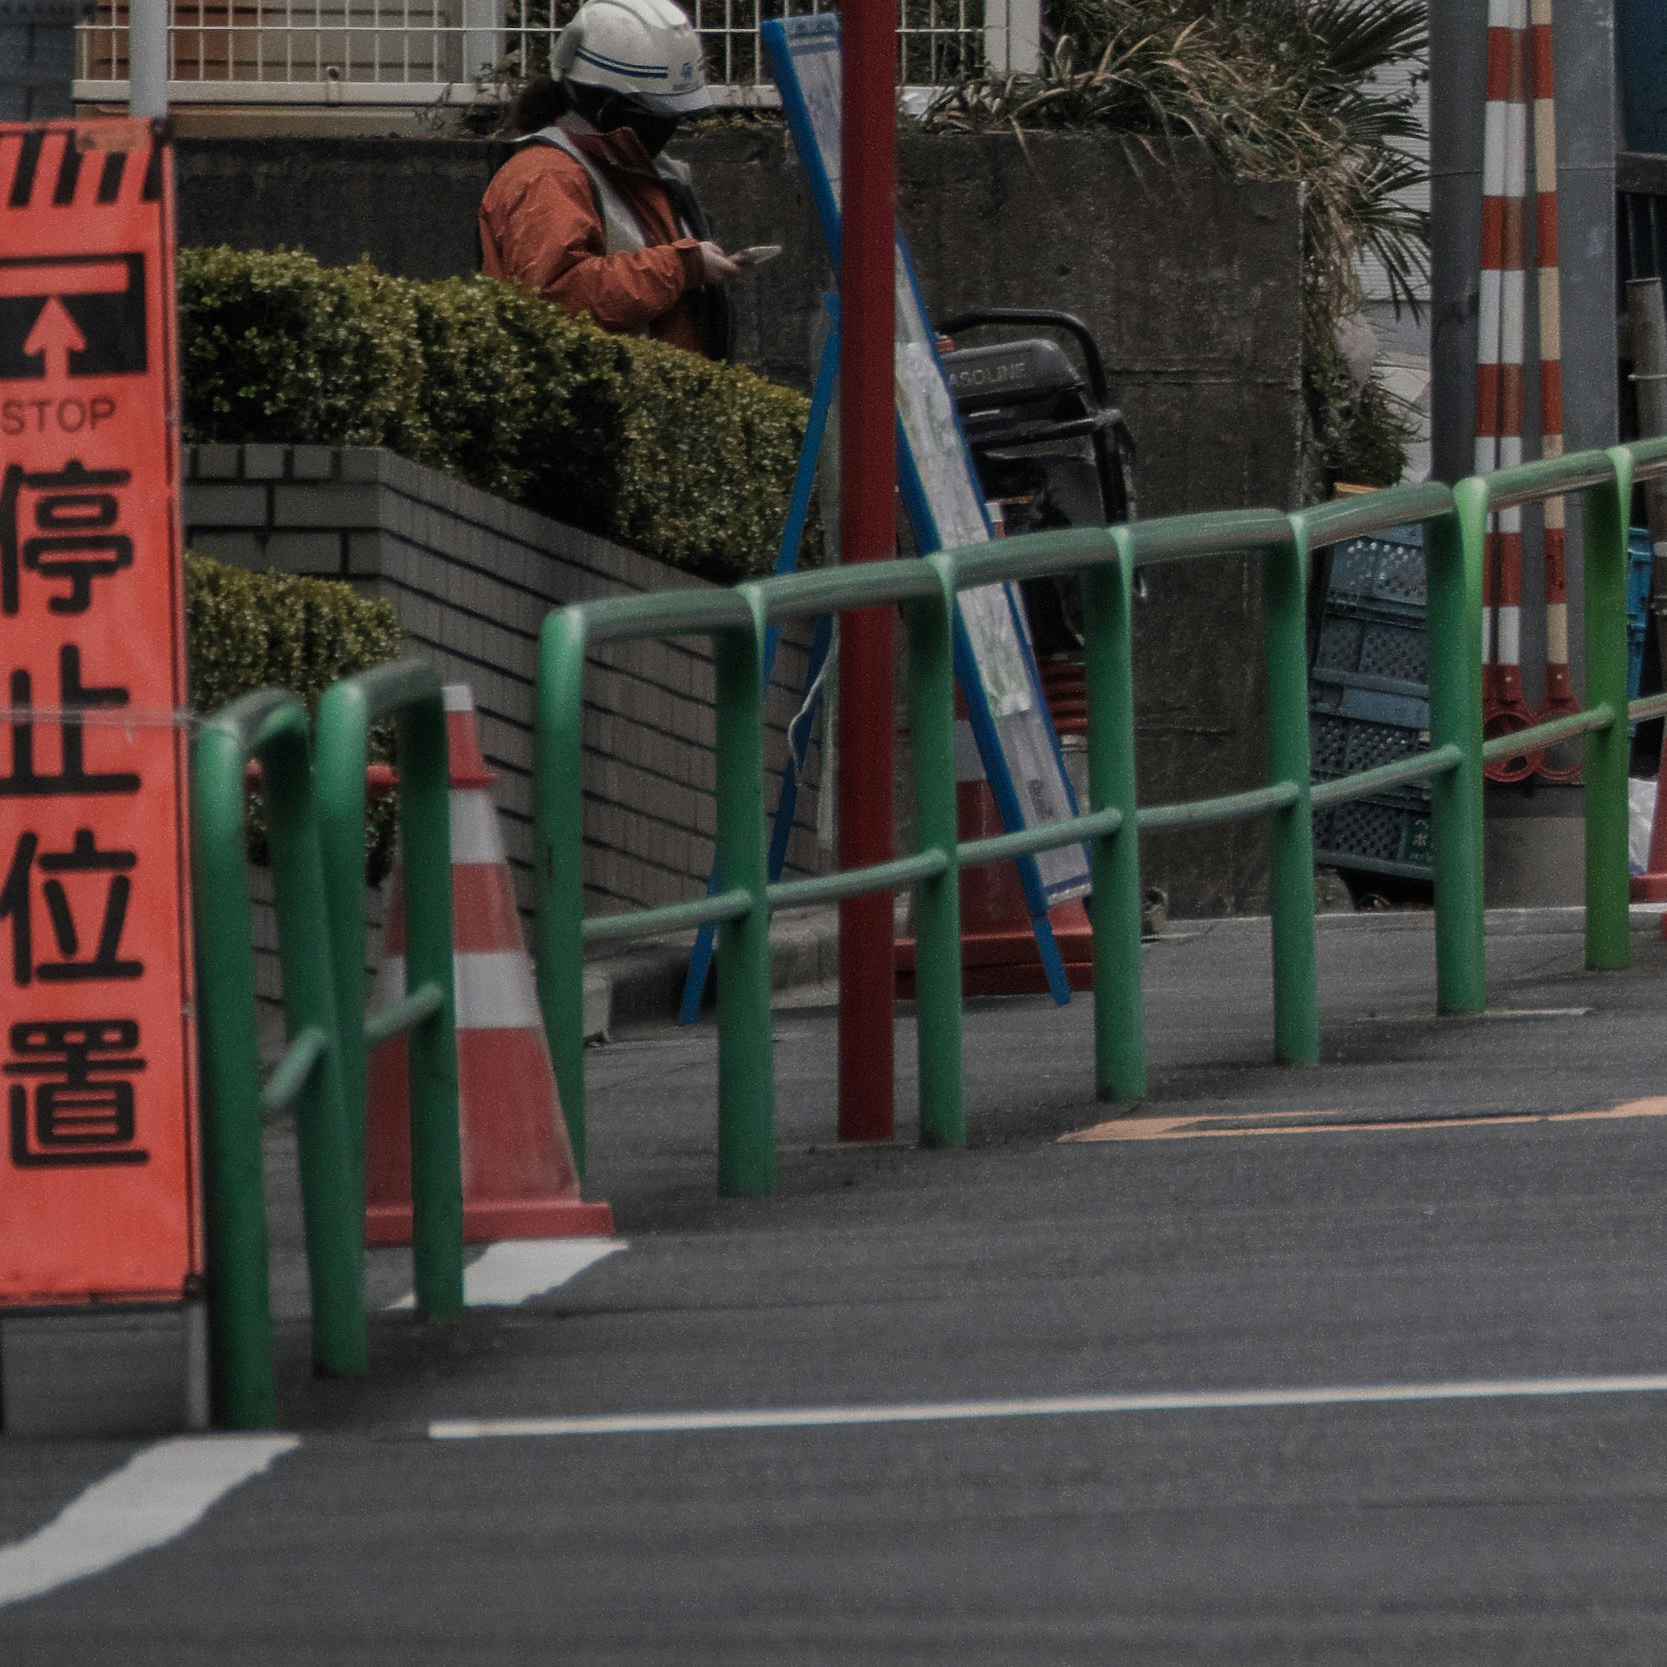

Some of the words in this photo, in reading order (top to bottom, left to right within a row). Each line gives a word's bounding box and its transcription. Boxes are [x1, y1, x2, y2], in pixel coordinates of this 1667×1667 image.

[947, 361, 1027, 388] ASOLINE
[1, 396, 118, 436] STOP
[0, 459, 152, 1170] 停止位置
